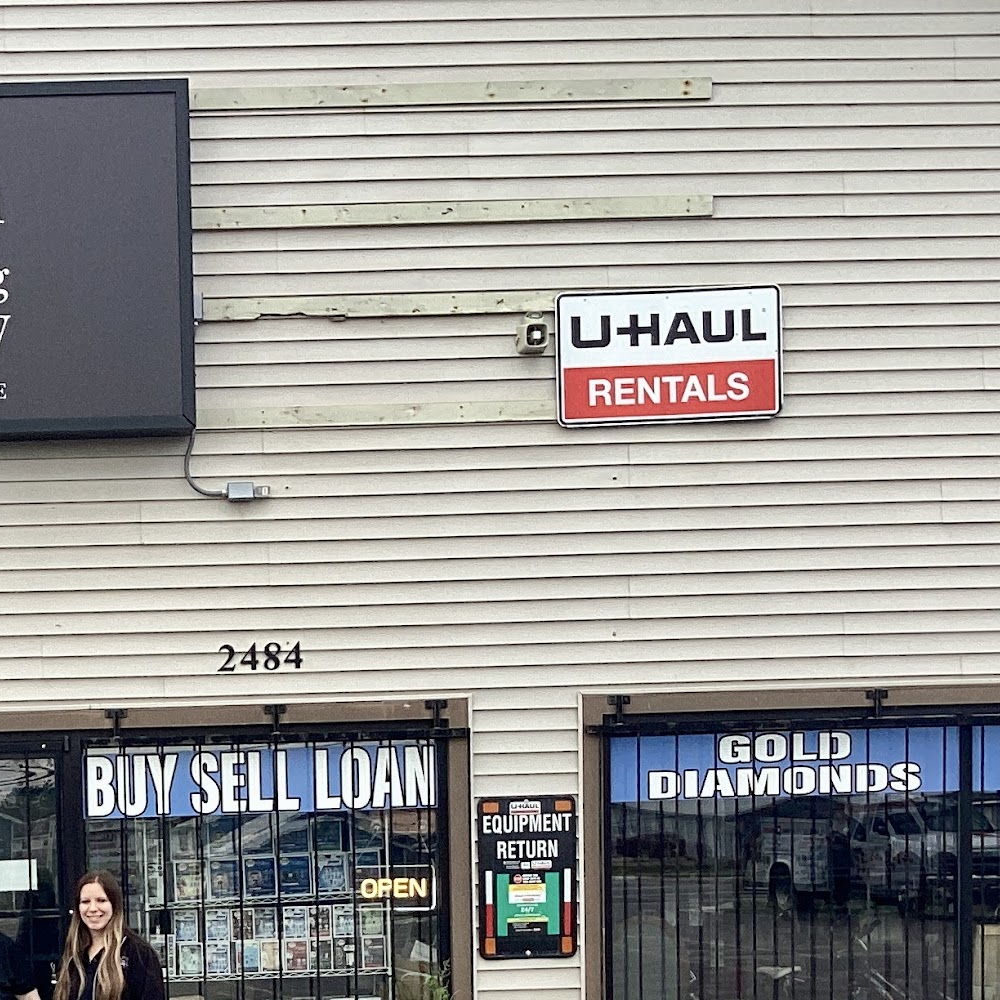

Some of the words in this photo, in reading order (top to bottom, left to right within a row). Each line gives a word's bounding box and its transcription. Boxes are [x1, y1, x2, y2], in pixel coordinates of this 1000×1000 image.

[570, 308, 768, 349] U-HAUL
[587, 371, 750, 407] RENTALS
[217, 640, 304, 672] 2484
[717, 730, 853, 764] GOLD
[85, 751, 178, 818] BUY
[189, 747, 301, 814] SELL
[315, 743, 437, 811] LOAN
[647, 761, 923, 800] DIAMONDS
[482, 813, 573, 835] EQUIPMENT
[496, 839, 559, 860] RETURN
[360, 877, 427, 899] OPEN
